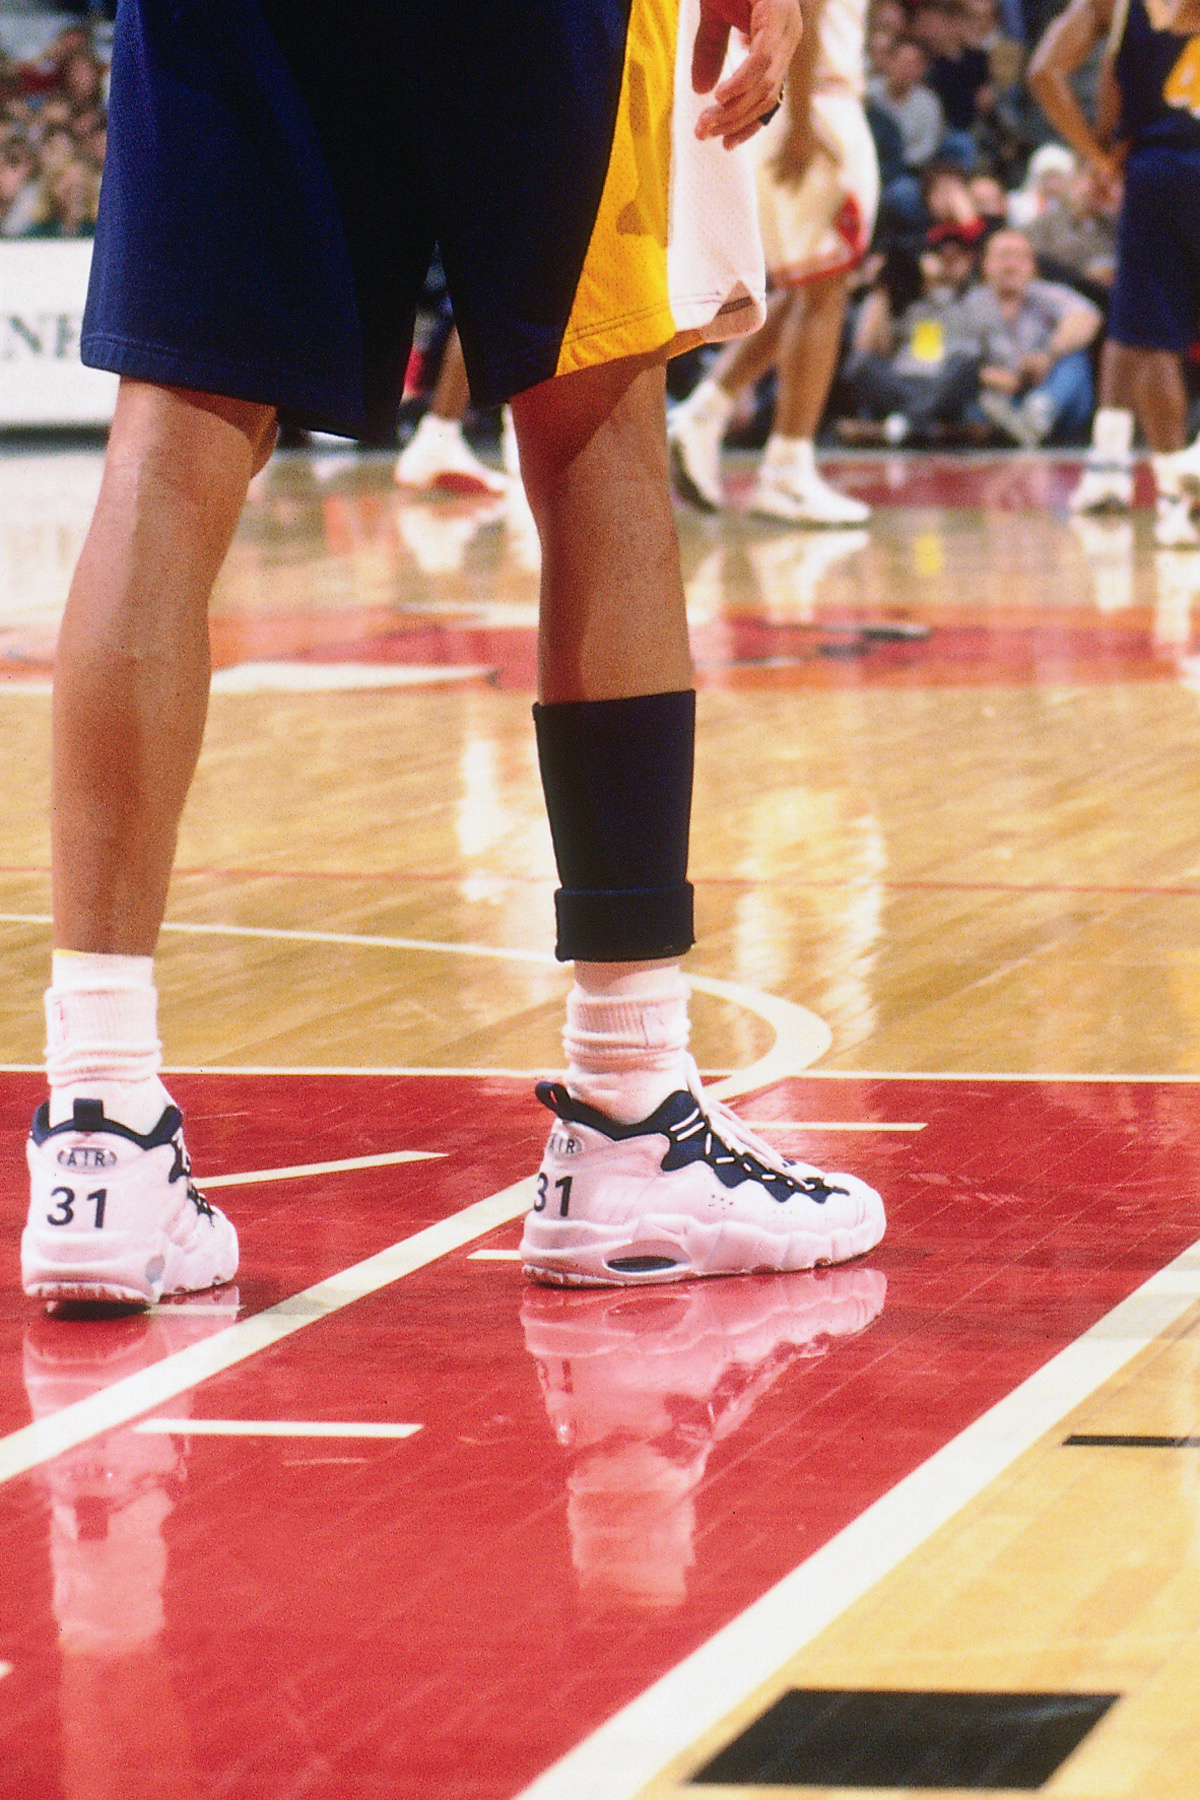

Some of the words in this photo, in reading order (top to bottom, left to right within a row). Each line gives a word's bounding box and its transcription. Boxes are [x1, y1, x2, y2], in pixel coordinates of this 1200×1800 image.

[66, 1151, 106, 1168] AIR
[46, 1186, 108, 1229] 31
[533, 1171, 574, 1218] 31
